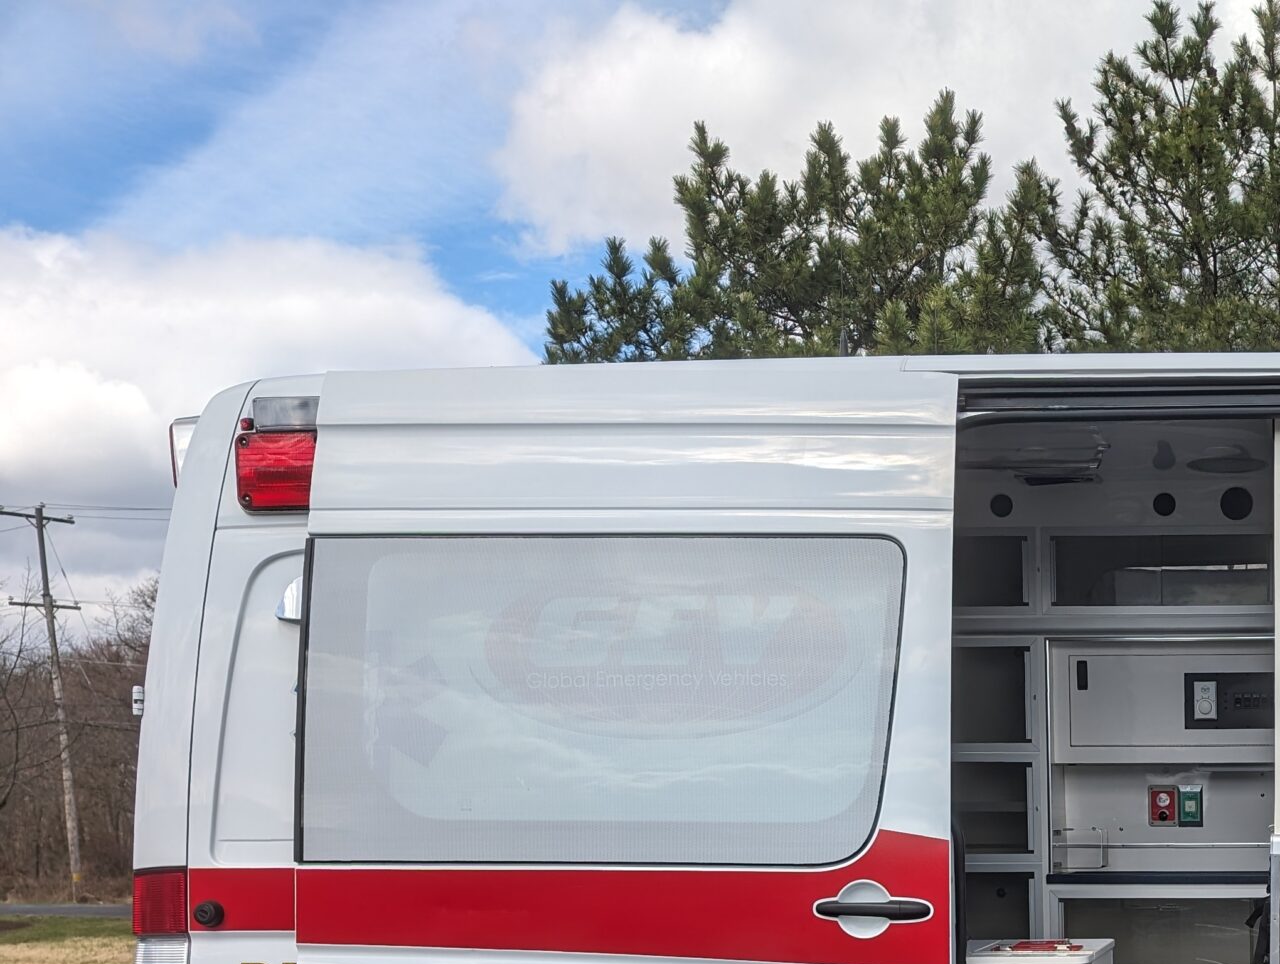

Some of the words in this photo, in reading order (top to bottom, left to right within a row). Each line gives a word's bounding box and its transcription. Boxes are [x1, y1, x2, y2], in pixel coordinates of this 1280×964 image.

[527, 596, 798, 668] GEV
[526, 671, 590, 689] Global
[596, 671, 702, 691] Emergency
